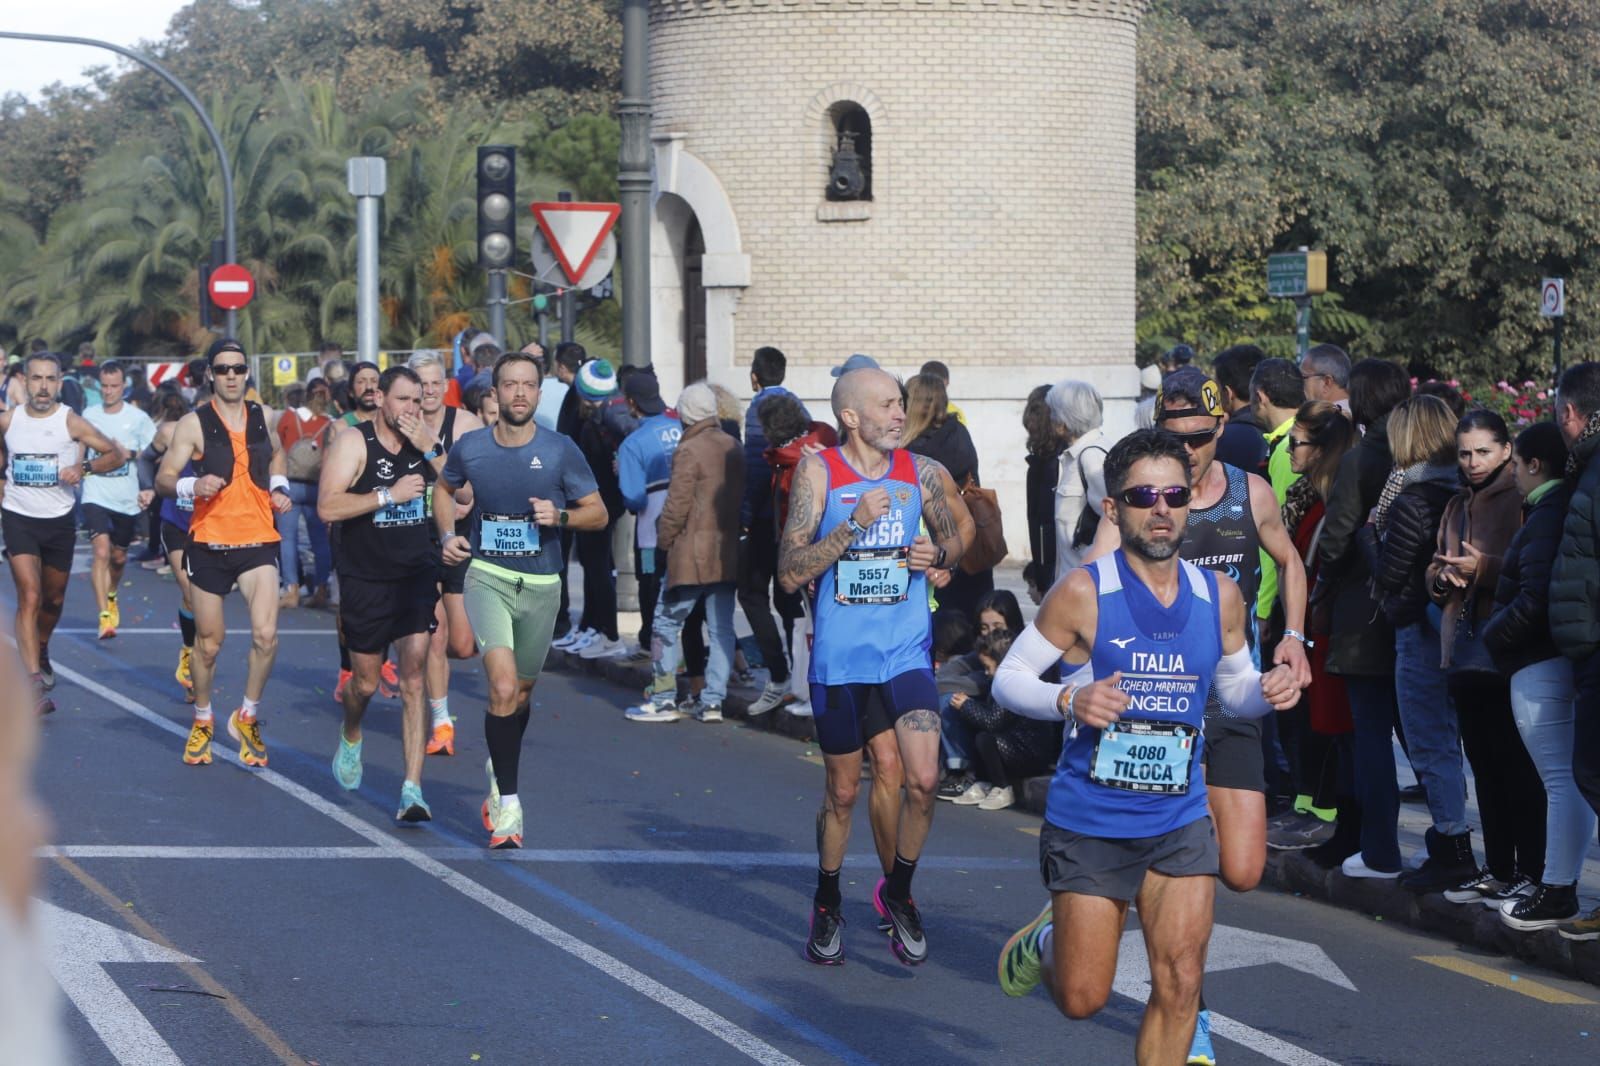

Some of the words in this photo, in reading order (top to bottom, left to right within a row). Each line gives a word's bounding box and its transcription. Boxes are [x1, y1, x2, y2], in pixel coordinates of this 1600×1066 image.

[496, 528, 522, 538] 5433
[494, 539, 525, 550] Vince
[858, 568, 890, 581] 5557
[849, 581, 899, 596] Macias
[1132, 652, 1185, 673] ITALIA
[1154, 681, 1196, 694] MARATHON
[1127, 695, 1190, 713] NGELO
[1127, 745, 1167, 761] 4080
[1113, 760, 1173, 781] TILOCA
